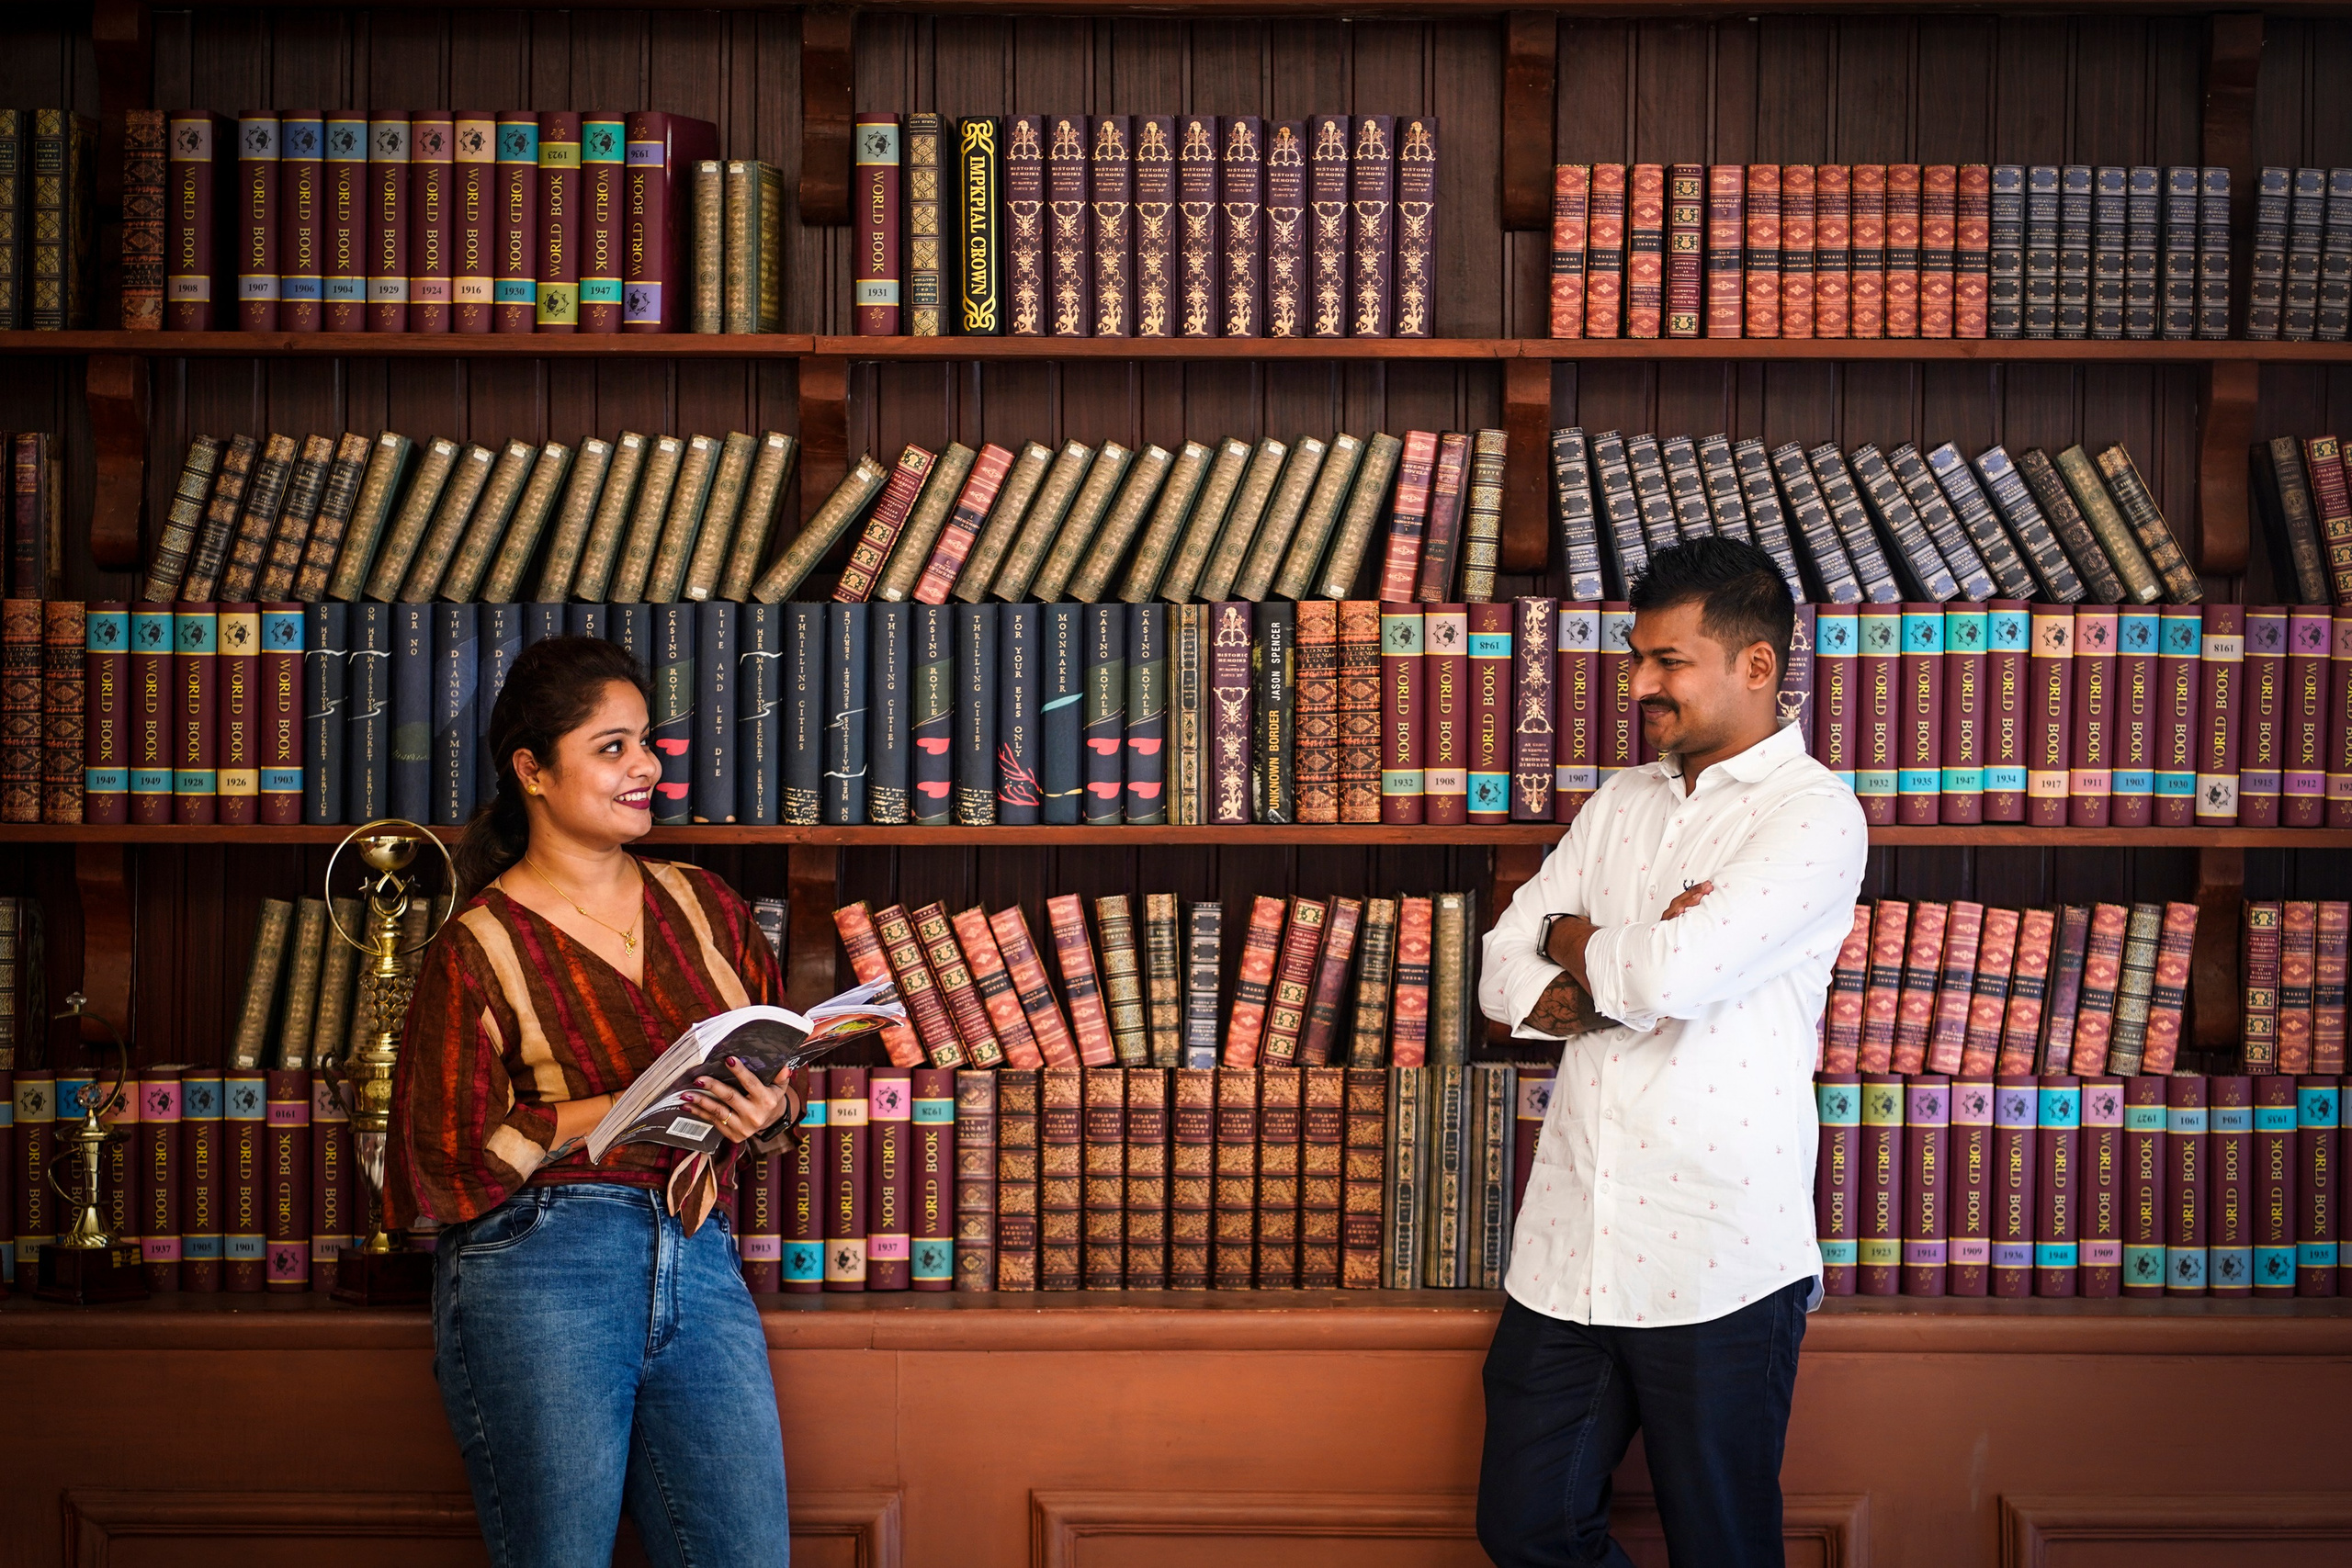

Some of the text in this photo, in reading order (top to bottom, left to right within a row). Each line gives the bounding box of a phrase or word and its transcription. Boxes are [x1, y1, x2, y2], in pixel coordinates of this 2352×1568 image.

[547, 150, 567, 160] 1923
[631, 150, 649, 158] 1936
[183, 166, 196, 268] WORLD BOOK
[253, 165, 266, 268] WORLD BOOK
[337, 167, 350, 270] WORLD BOOK
[383, 168, 396, 270] WORLD BOOK
[426, 168, 439, 271] WORLD BOOK
[466, 167, 479, 270] WORLD BOOK
[549, 175, 563, 277] WORLD BOOK
[595, 168, 609, 271] WORLD BOOK
[632, 173, 644, 276] WORLD BOOK
[872, 170, 885, 273] WORLD BOOK
[179, 284, 198, 293] 1908
[247, 283, 268, 292] 1907
[333, 285, 354, 294] 1904
[379, 285, 400, 295] 1929
[423, 286, 441, 295] 1924
[461, 286, 481, 294] 1916
[590, 286, 611, 295] 1947
[868, 288, 888, 297] 1931
[970, 236, 987, 296] CROWN
[320, 605, 328, 620] ON
[410, 612, 419, 656] DR NO
[718, 609, 726, 649] LIVE
[797, 614, 807, 691] THRILLING
[1479, 641, 1499, 650] 1948
[2213, 644, 2233, 652] 1918
[668, 610, 678, 716] CASINO ROYALE
[716, 662, 725, 692] AND
[1013, 615, 1023, 757] FOR YOUR EYES ONLY
[1057, 613, 1068, 693] MOONRAKER
[1271, 622, 1281, 702] JASON SPENCER
[100, 659, 114, 761] WORLD BOOK
[187, 660, 200, 762] WORLD BOOK
[231, 660, 243, 762] WORLD BOOK
[277, 658, 291, 761] WORLD BOOK
[449, 610, 460, 818] THE DIAMOND SMUGGLERS
[715, 705, 723, 735] LET
[1396, 661, 1410, 763] WORLD BOOK
[1440, 660, 1453, 762] WORLD BOOK
[1482, 665, 1495, 767] WORLD BOOK
[1573, 657, 1587, 759] WORLD BOOK
[1873, 661, 1888, 764] WORLD BOOK
[1917, 660, 1930, 762] WORLD BOOK
[1961, 659, 1974, 761] WORLD BOOK
[2047, 662, 2062, 765] WORLD BOOK
[2087, 660, 2102, 763] WORLD BOOK
[2213, 668, 2229, 770] WORLD BOOK
[2301, 662, 2317, 764] WORLD BOOK
[96, 775, 117, 784] 1949
[183, 777, 204, 787] 1928
[226, 778, 247, 786] 1926
[273, 775, 294, 784] 1903
[1268, 710, 1280, 809] UNKNOWN BORDER
[1393, 778, 1414, 787] 1932
[1435, 777, 1455, 785] 1908
[1569, 773, 1589, 783] 1907
[1869, 778, 1889, 788] 1932
[1912, 777, 1932, 786] 1935
[1955, 776, 1975, 785] 1947
[2041, 780, 2062, 788] 1917
[2083, 778, 2102, 787] 1911
[2297, 779, 2316, 788] 1912
[841, 807, 849, 821] ON
[275, 1110, 295, 1119] 1910
[837, 1108, 857, 1117] 1916
[155, 1127, 167, 1230] WORLD BOOK
[240, 1125, 252, 1228] WORLD BOOK
[278, 1134, 291, 1237] WORLD BOOK
[841, 1132, 854, 1234] WORLD BOOK
[882, 1125, 896, 1228] WORLD BOOK
[1831, 1131, 1846, 1233] WORLD BOOK
[1967, 1130, 1982, 1232] WORLD BOOK
[2140, 1137, 2153, 1240] WORLD BOOK
[2182, 1139, 2195, 1242] WORLD BOOK
[151, 1245, 171, 1254] 1937
[235, 1243, 254, 1252] 1901
[877, 1242, 898, 1252] 1937
